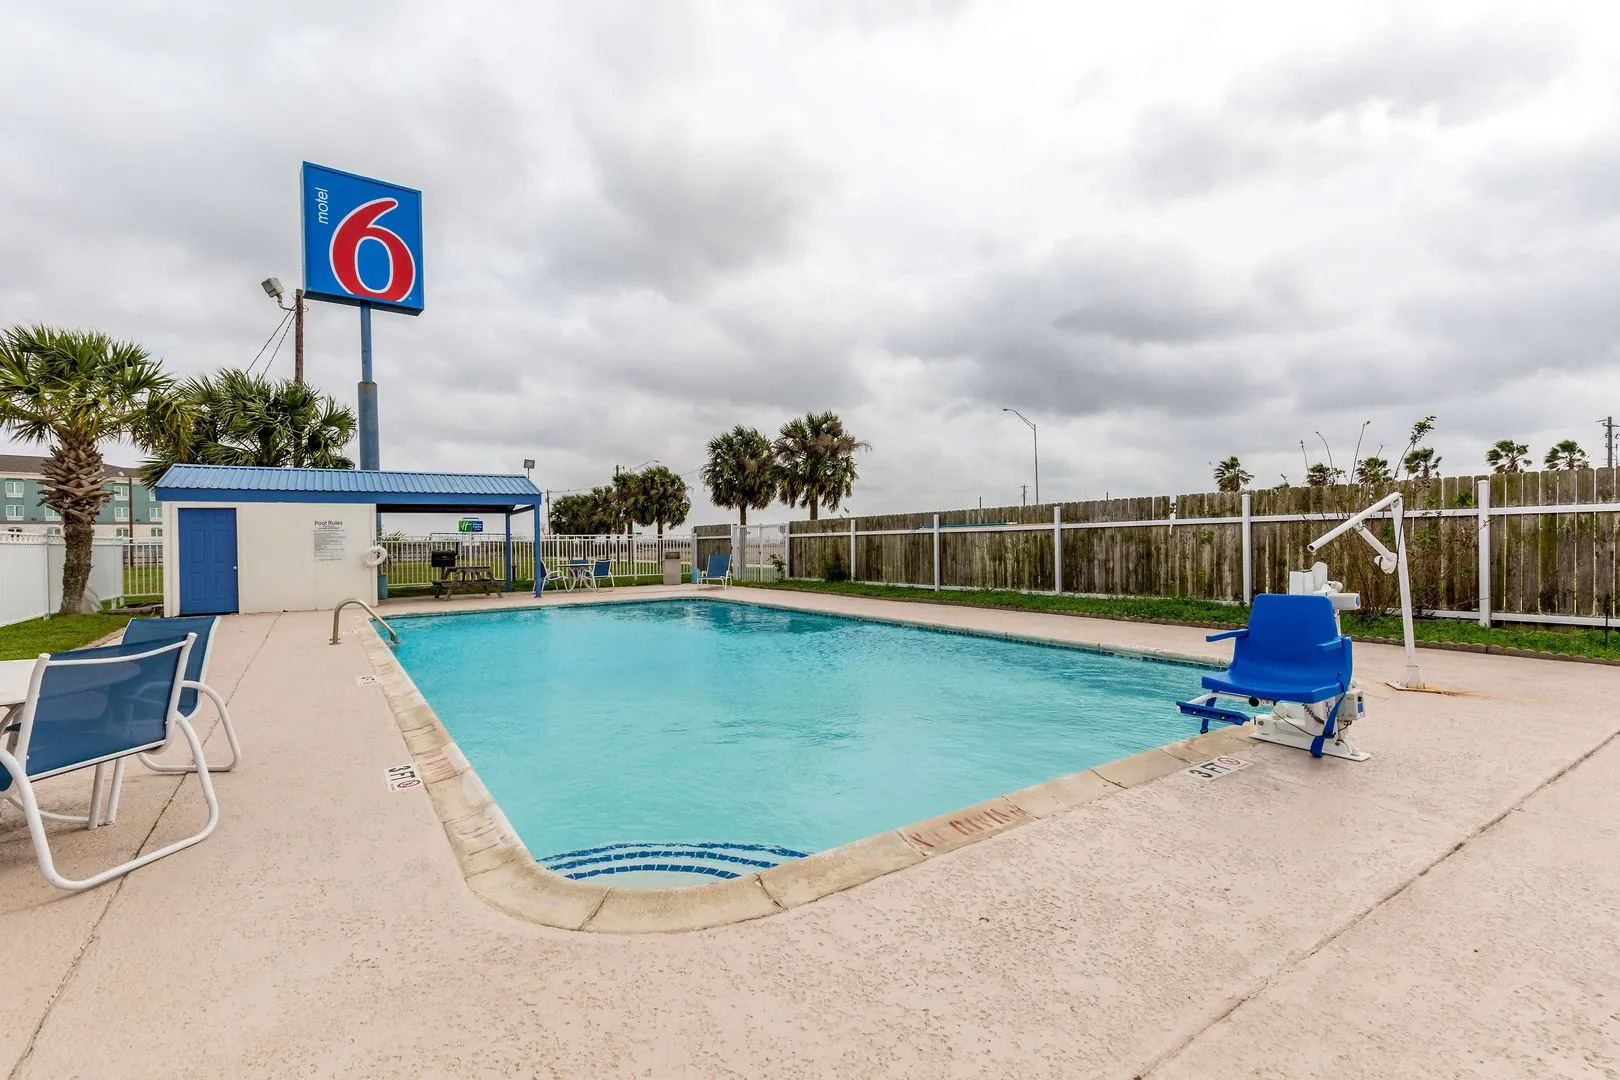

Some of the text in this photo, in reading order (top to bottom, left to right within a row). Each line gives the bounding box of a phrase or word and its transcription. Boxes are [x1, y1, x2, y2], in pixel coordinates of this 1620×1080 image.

[314, 187, 328, 225] motel
[329, 197, 416, 303] 6
[388, 765, 416, 782] 3 FT
[1189, 769, 1213, 779] 3
[1200, 762, 1231, 774] FT
